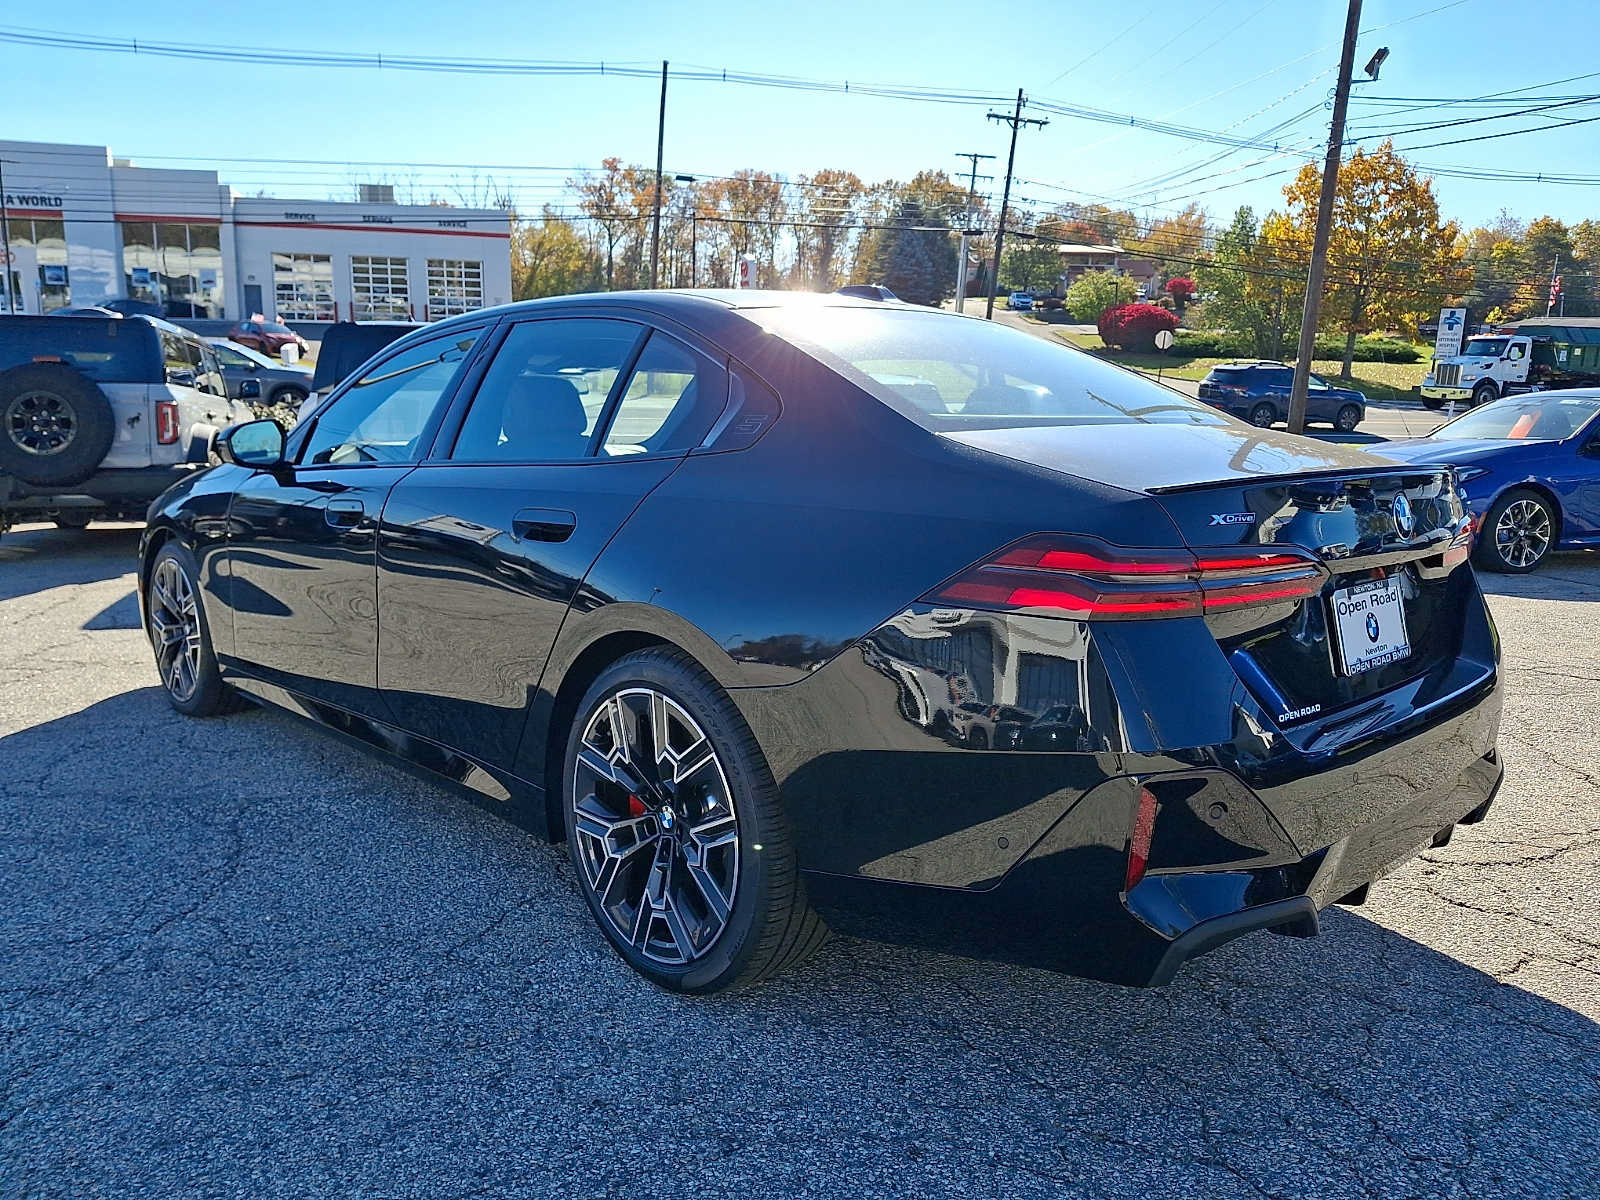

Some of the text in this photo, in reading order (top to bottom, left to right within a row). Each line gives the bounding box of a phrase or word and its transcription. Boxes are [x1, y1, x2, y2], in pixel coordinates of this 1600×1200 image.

[16, 195, 63, 207] WORLD
[1338, 591, 1397, 617] Open Road
[1365, 643, 1388, 656] Newton
[1351, 647, 1410, 674] OPEN ROAD BMW
[1278, 704, 1321, 723] OPEN ROAD
